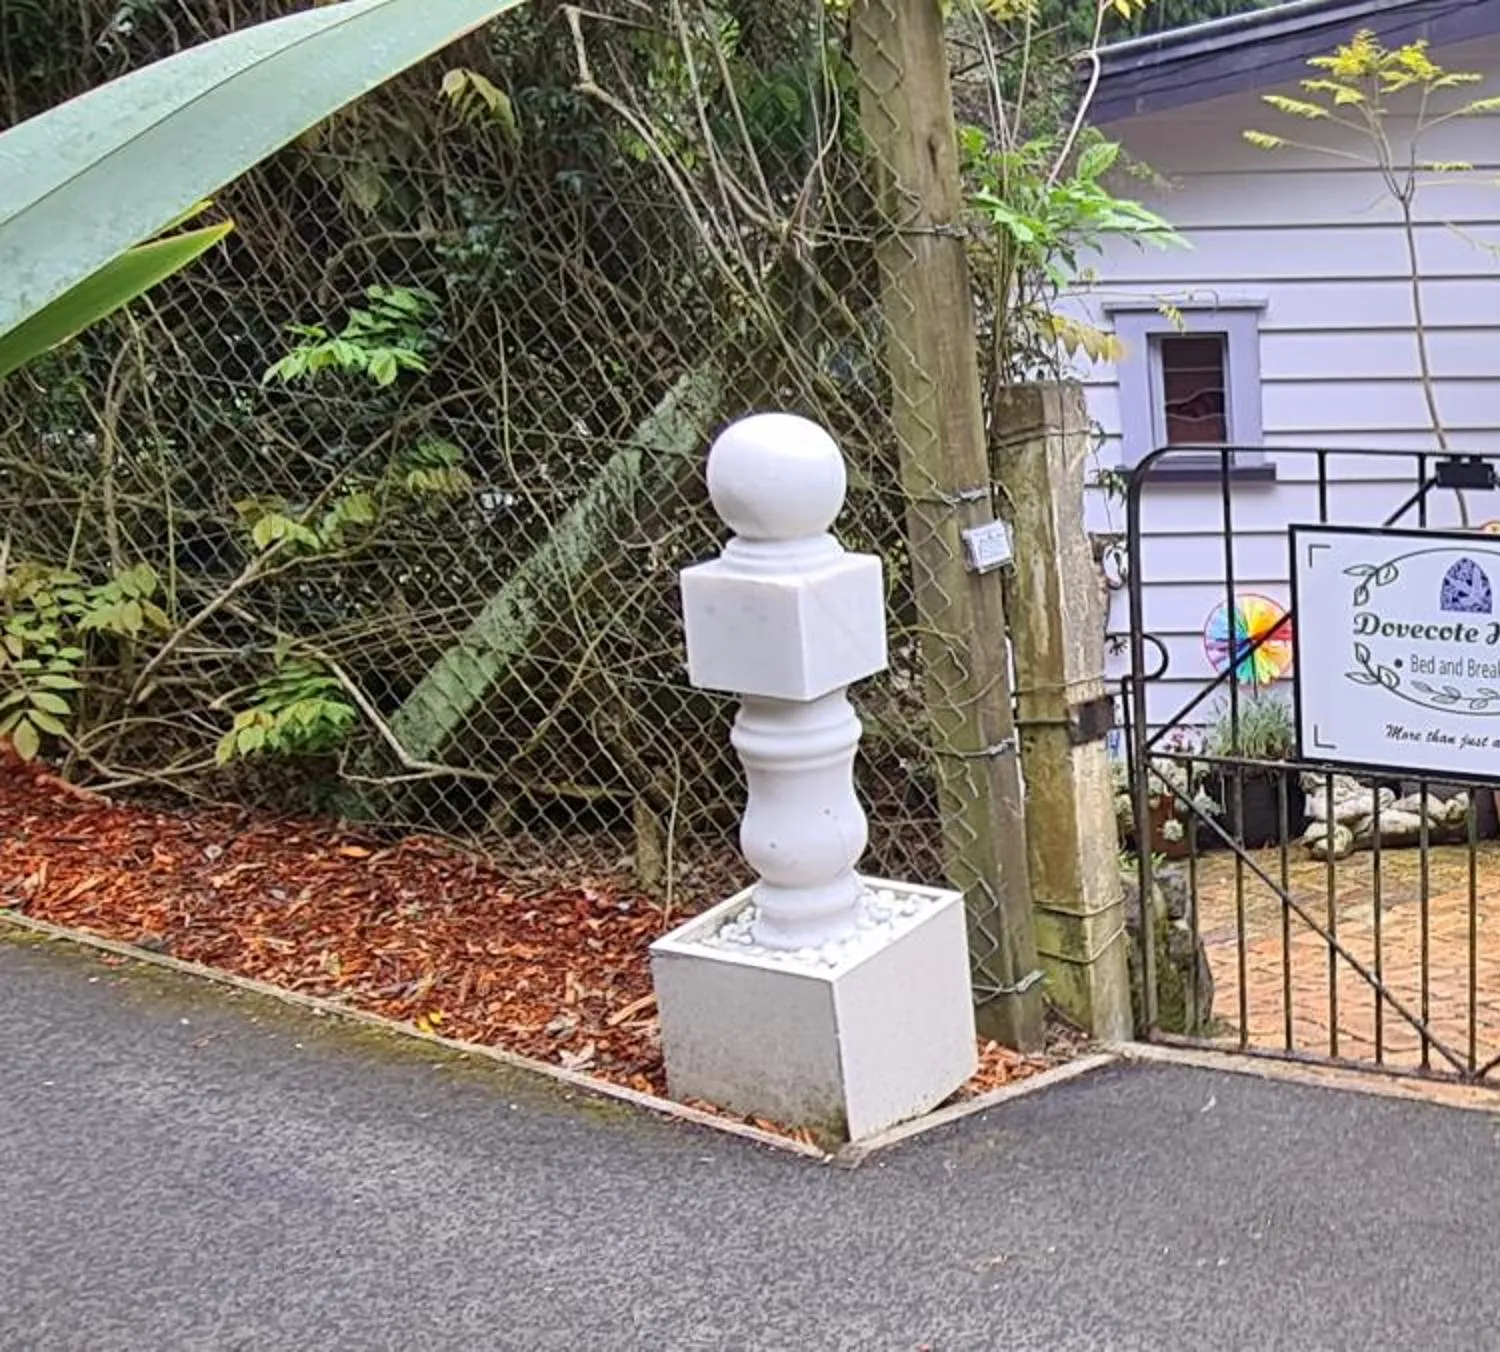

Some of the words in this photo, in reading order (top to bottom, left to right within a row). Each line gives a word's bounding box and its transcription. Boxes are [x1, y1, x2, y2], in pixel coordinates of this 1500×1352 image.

[1353, 611, 1479, 642] Dovecote
[1410, 654, 1435, 675] Bed
[1440, 656, 1463, 677] and
[1385, 724, 1422, 741] More
[1425, 728, 1456, 745] than
[1459, 734, 1489, 750] just
